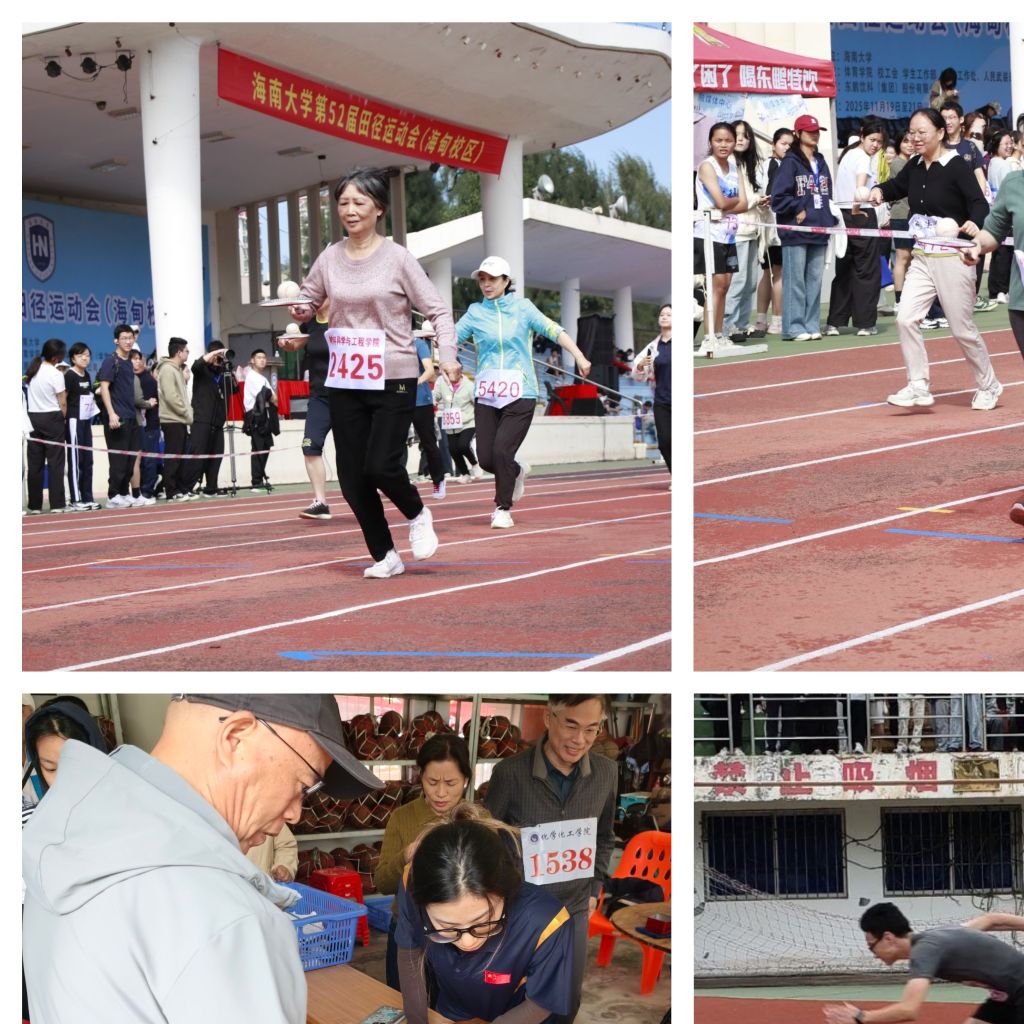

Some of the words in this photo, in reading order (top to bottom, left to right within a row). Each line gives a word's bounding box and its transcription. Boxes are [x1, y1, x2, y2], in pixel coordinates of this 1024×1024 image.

[740, 64, 819, 93] 喝东鹏特饮
[329, 352, 383, 380] 2425
[479, 380, 520, 398] 5420
[530, 847, 592, 877] 1538
